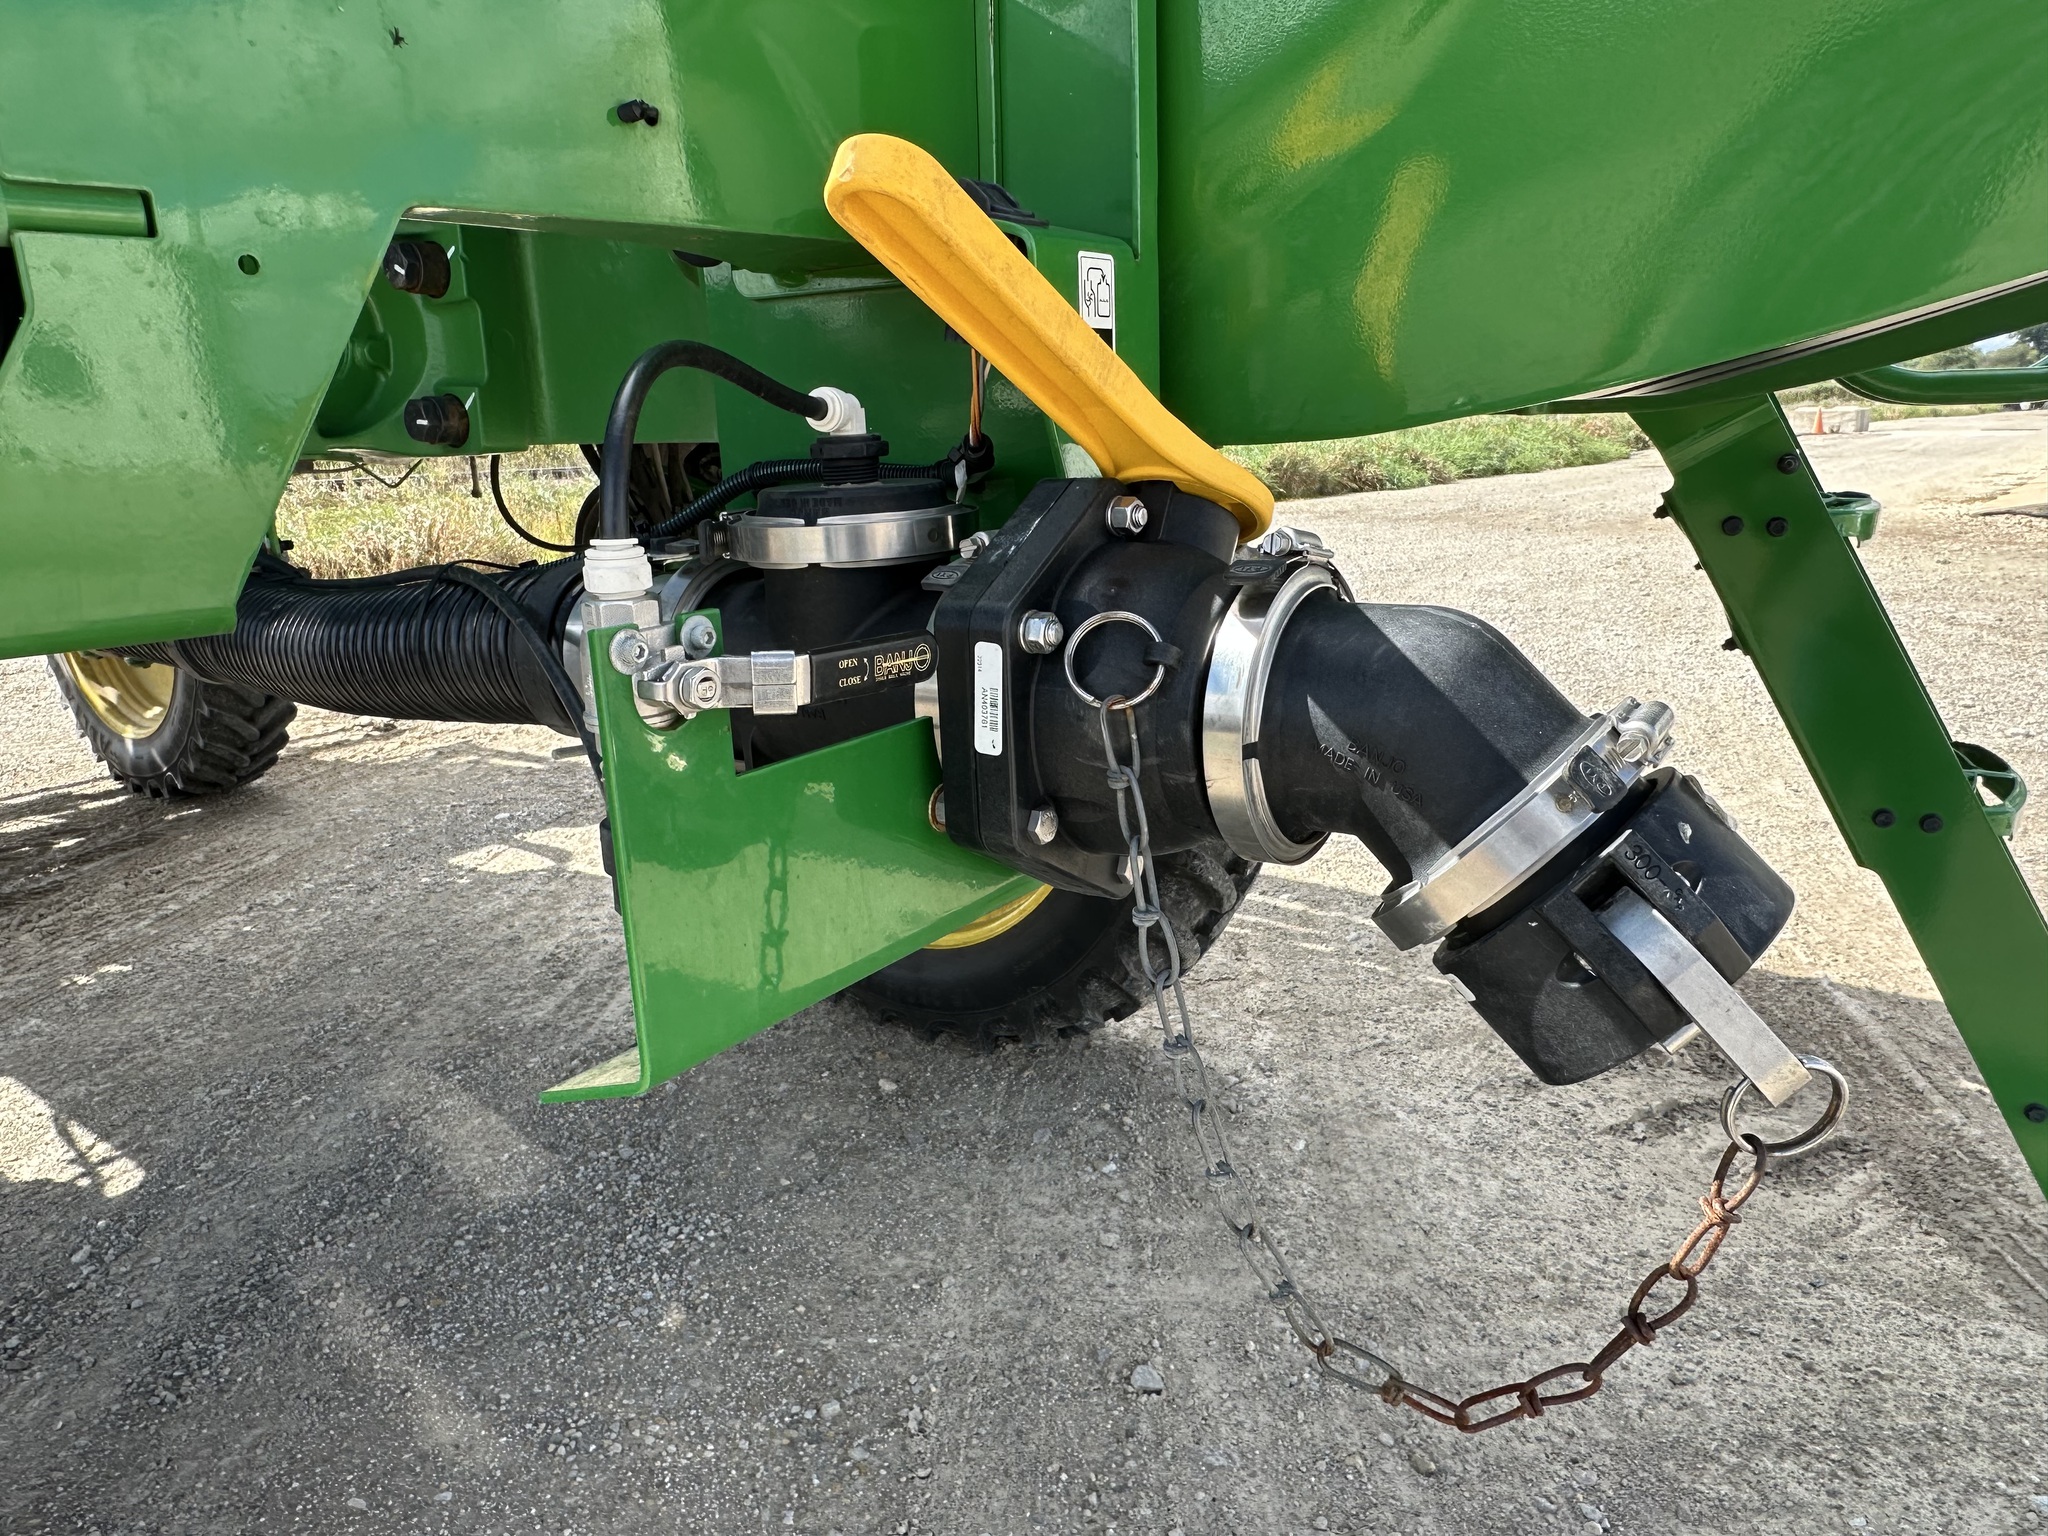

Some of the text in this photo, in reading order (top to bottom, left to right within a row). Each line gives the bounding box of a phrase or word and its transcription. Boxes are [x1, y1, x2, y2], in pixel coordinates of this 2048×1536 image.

[838, 658, 859, 669] OPEN
[874, 643, 931, 677] BANJO
[838, 675, 862, 688] CLOSE
[1313, 742, 1423, 808] MADE IN USA
